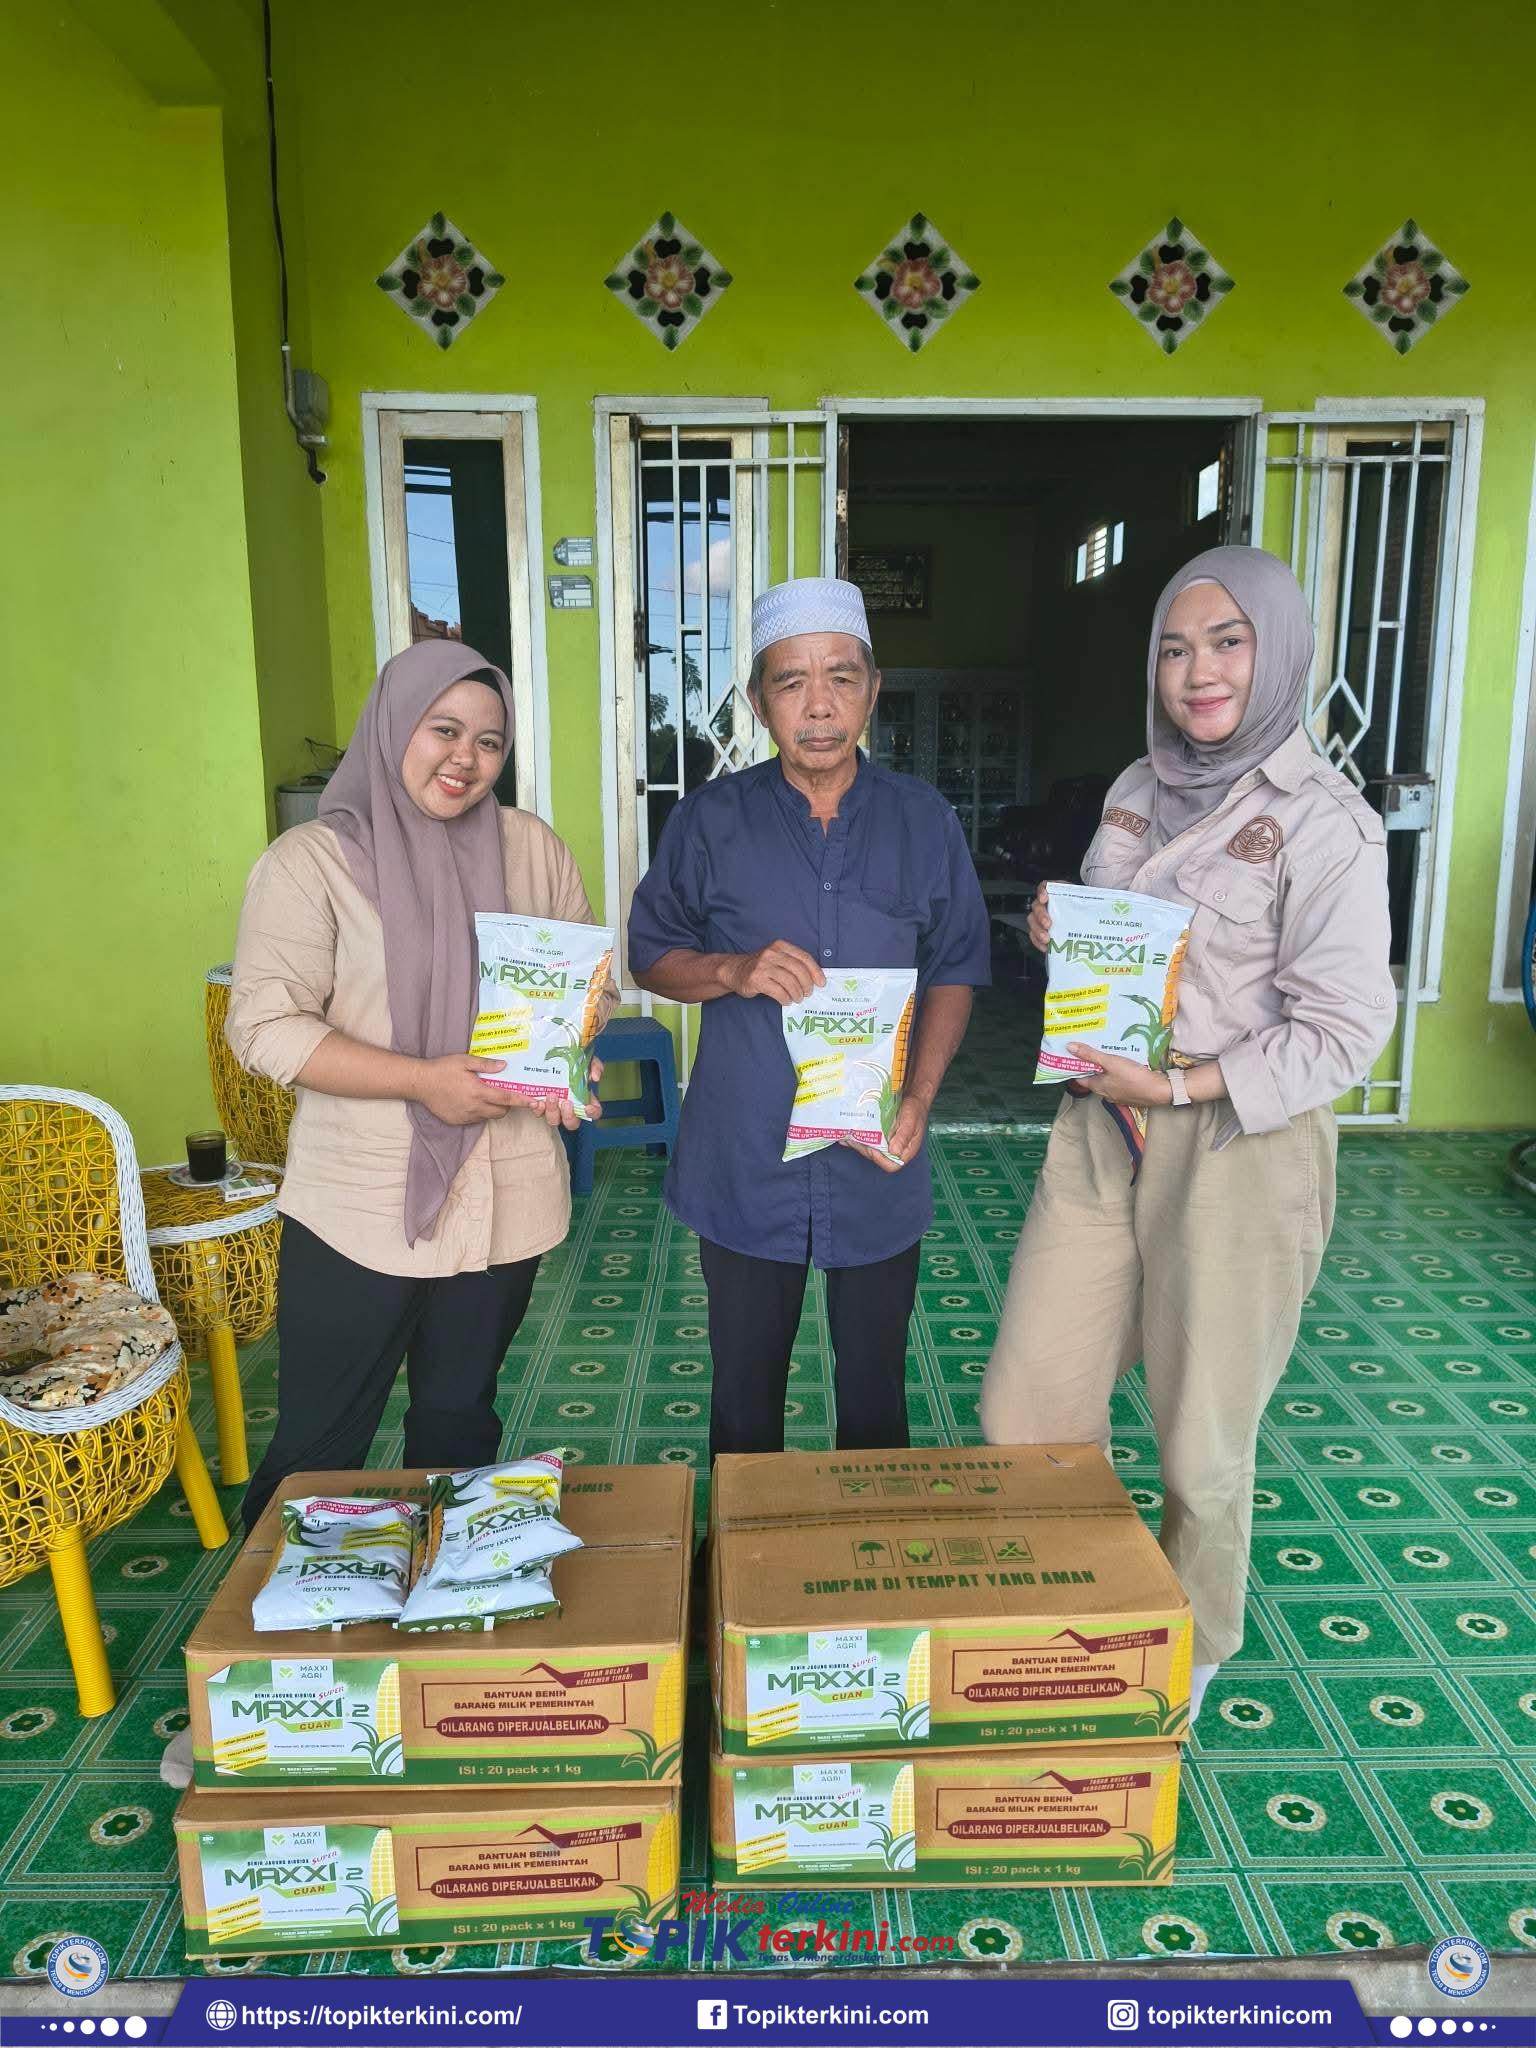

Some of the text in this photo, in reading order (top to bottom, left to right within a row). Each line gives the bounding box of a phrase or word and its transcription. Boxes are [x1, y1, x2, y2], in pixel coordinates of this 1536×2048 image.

[1049, 938, 1146, 964] MAXXI
[481, 961, 567, 988] MAXXI
[787, 1016, 874, 1035] MAXXI
[940, 1461, 1013, 1470] JANGAN
[352, 1487, 401, 1497] AMAN
[478, 1504, 506, 1518] CUAN
[476, 1536, 521, 1552] MAXXI AGRI
[300, 1562, 406, 1583] MAXXI
[803, 1570, 1096, 1594] SIMPAN DI TEMPAT YANG AMAN
[852, 1656, 877, 1670] SUPER
[1012, 1656, 1058, 1665] BANTUAN
[983, 1664, 1115, 1676] BARANG MILIK PEMERINTAH
[768, 1667, 874, 1695] MAXXI
[319, 1686, 344, 1700] SUPER
[484, 1690, 567, 1699] BANTUAN BENIH
[832, 1691, 863, 1701] CUAN
[968, 1682, 1124, 1698] DILARANG DIPERJUALBELIKAN.
[232, 1697, 343, 1724] MAXXI
[454, 1699, 594, 1710] BARANG MILIK PEMERINTAH
[300, 1721, 331, 1730] CUAN
[441, 1719, 605, 1733] DILARANG DIPERJUALBELIKAN.
[981, 1728, 997, 1736] ISI
[1008, 1727, 1023, 1735] 20
[1026, 1726, 1056, 1737] pack
[1081, 1723, 1097, 1733] kg
[459, 1766, 476, 1776] ISI
[488, 1765, 503, 1775] 20
[507, 1764, 538, 1776] pack
[554, 1765, 561, 1773] 1
[565, 1764, 582, 1775] kg
[837, 1788, 862, 1800] SUPER
[755, 1800, 859, 1824] MAXXI
[818, 1821, 848, 1830] CUAN
[952, 1823, 1107, 1835] DILARANG DIPERJUALBELIKAN.
[312, 1851, 337, 1865] SUPER
[479, 1850, 561, 1861] BANTUAN BENIH
[449, 1859, 588, 1872] BARANG MILIK PEMERINTAH
[966, 1866, 982, 1875] ISI
[992, 1865, 1008, 1874] 20
[1011, 1864, 1040, 1876] pack
[1055, 1865, 1062, 1873] 1
[1065, 1864, 1081, 1874] kg
[225, 1864, 336, 1890] MAXXI
[294, 1886, 325, 1896] CUAN
[435, 1877, 598, 1894] DILARANG DIPERJUALBELIKAN.
[454, 1925, 471, 1934] ISI
[482, 1923, 498, 1933] 20
[501, 1922, 533, 1934] pack
[549, 1921, 556, 1929] 1
[559, 1920, 576, 1930] kg
